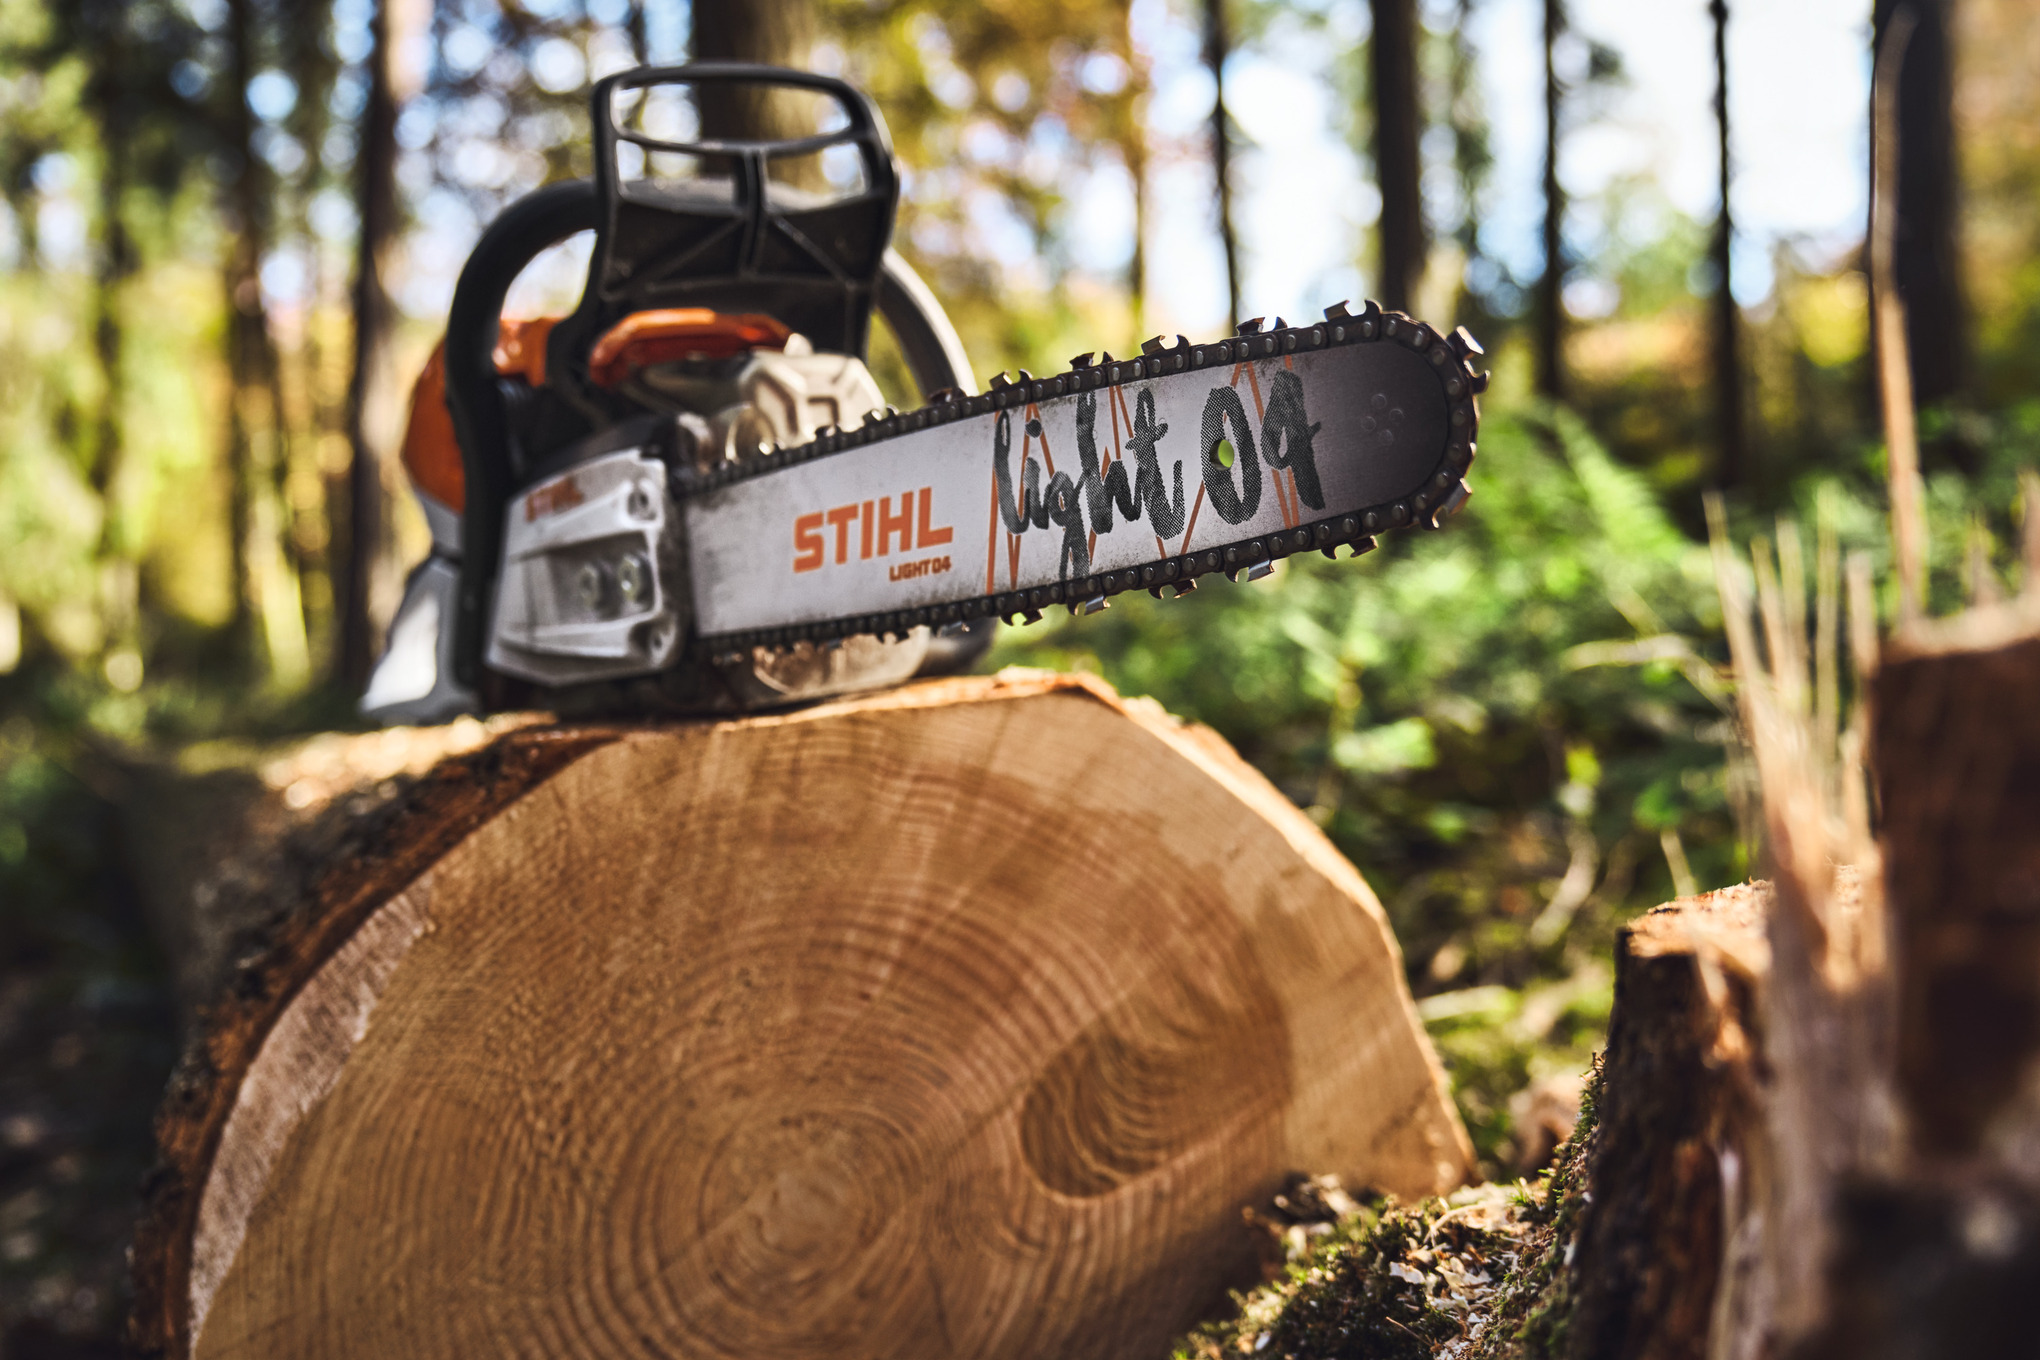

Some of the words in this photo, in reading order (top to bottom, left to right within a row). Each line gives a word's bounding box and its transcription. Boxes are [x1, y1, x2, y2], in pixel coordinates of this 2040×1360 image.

[994, 391, 1186, 579] light
[794, 486, 953, 573] STIHL
[889, 559, 931, 582] LIGHT
